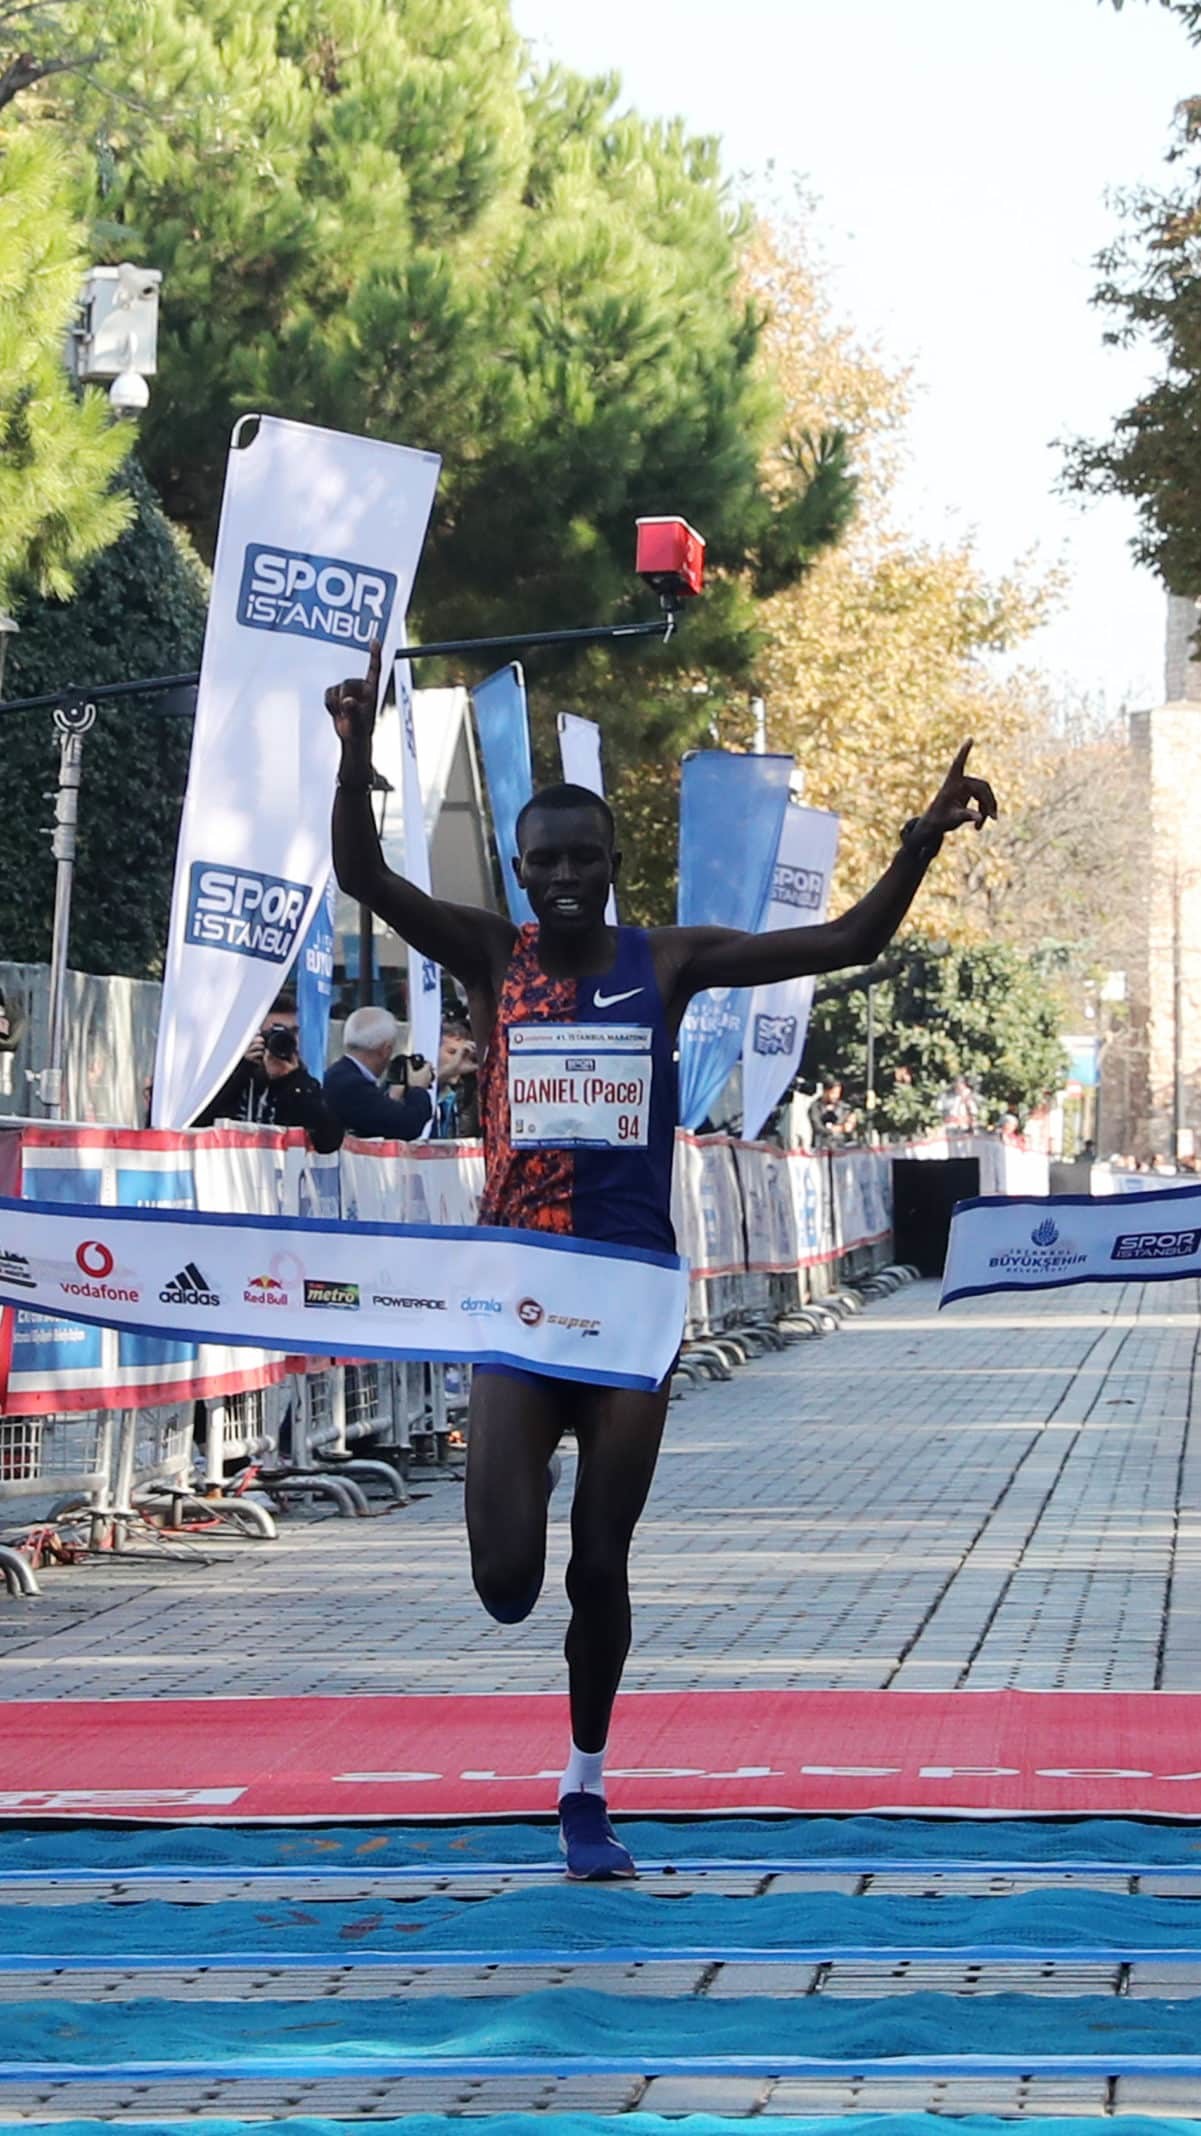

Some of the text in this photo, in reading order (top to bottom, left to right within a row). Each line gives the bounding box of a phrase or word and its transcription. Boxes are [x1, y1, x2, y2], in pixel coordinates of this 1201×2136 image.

[251, 553, 387, 619] SPOR
[197, 871, 305, 931] SPOR
[513, 1078, 645, 1107] DANIEL (Pace)
[618, 1115, 640, 1140] 94
[1119, 1233, 1195, 1250] SPOR
[989, 1253, 1088, 1269] BÜYÜKŞEHİR
[60, 1283, 140, 1303] vodafone
[159, 1288, 221, 1306] adidas
[243, 1291, 288, 1305] Red Bull
[307, 1285, 356, 1303] metro
[372, 1294, 448, 1311] POWERADE
